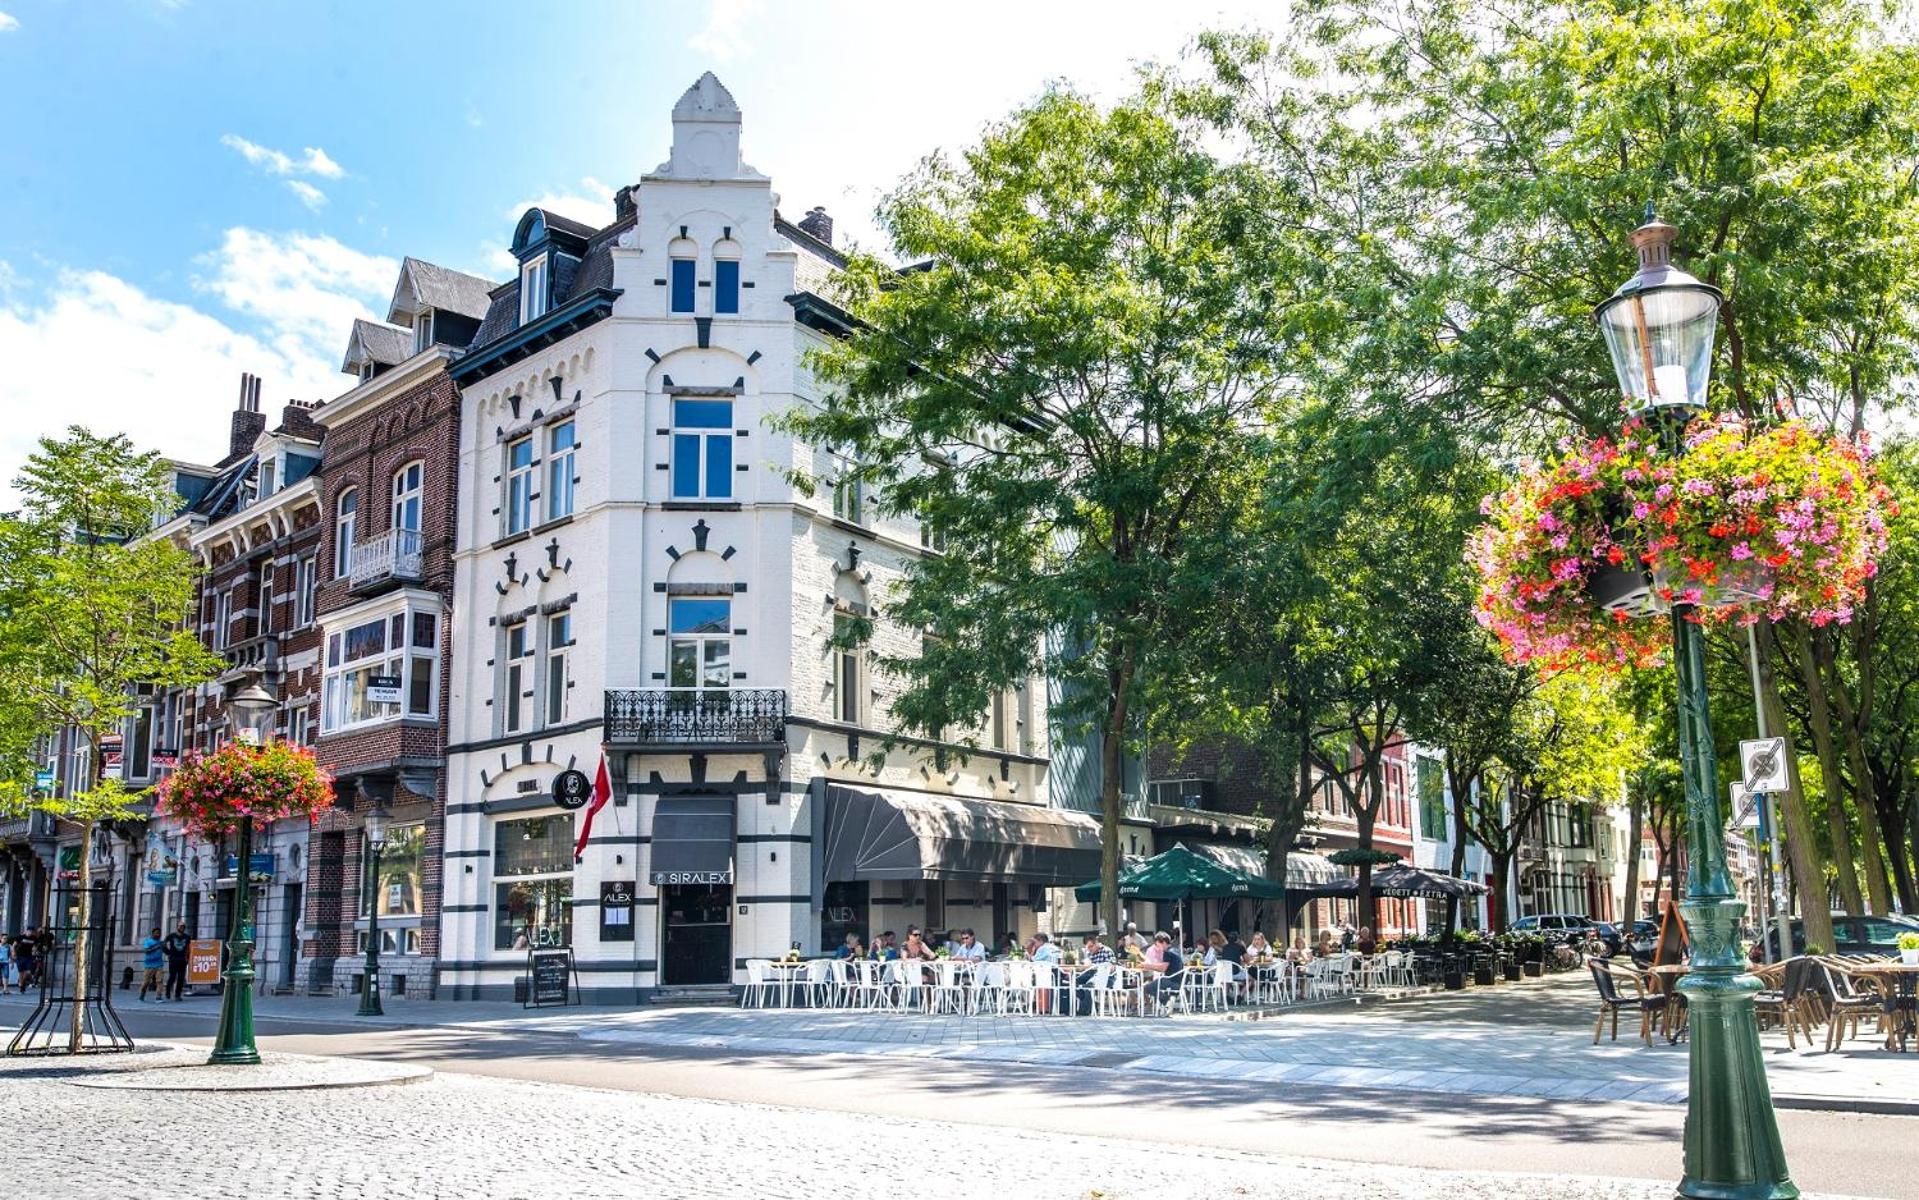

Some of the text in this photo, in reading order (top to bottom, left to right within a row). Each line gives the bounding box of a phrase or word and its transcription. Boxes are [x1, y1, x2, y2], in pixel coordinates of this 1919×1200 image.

[669, 872, 727, 885] SIRALEX
[603, 893, 632, 902] ALEX
[1419, 888, 1448, 900] EXTRA
